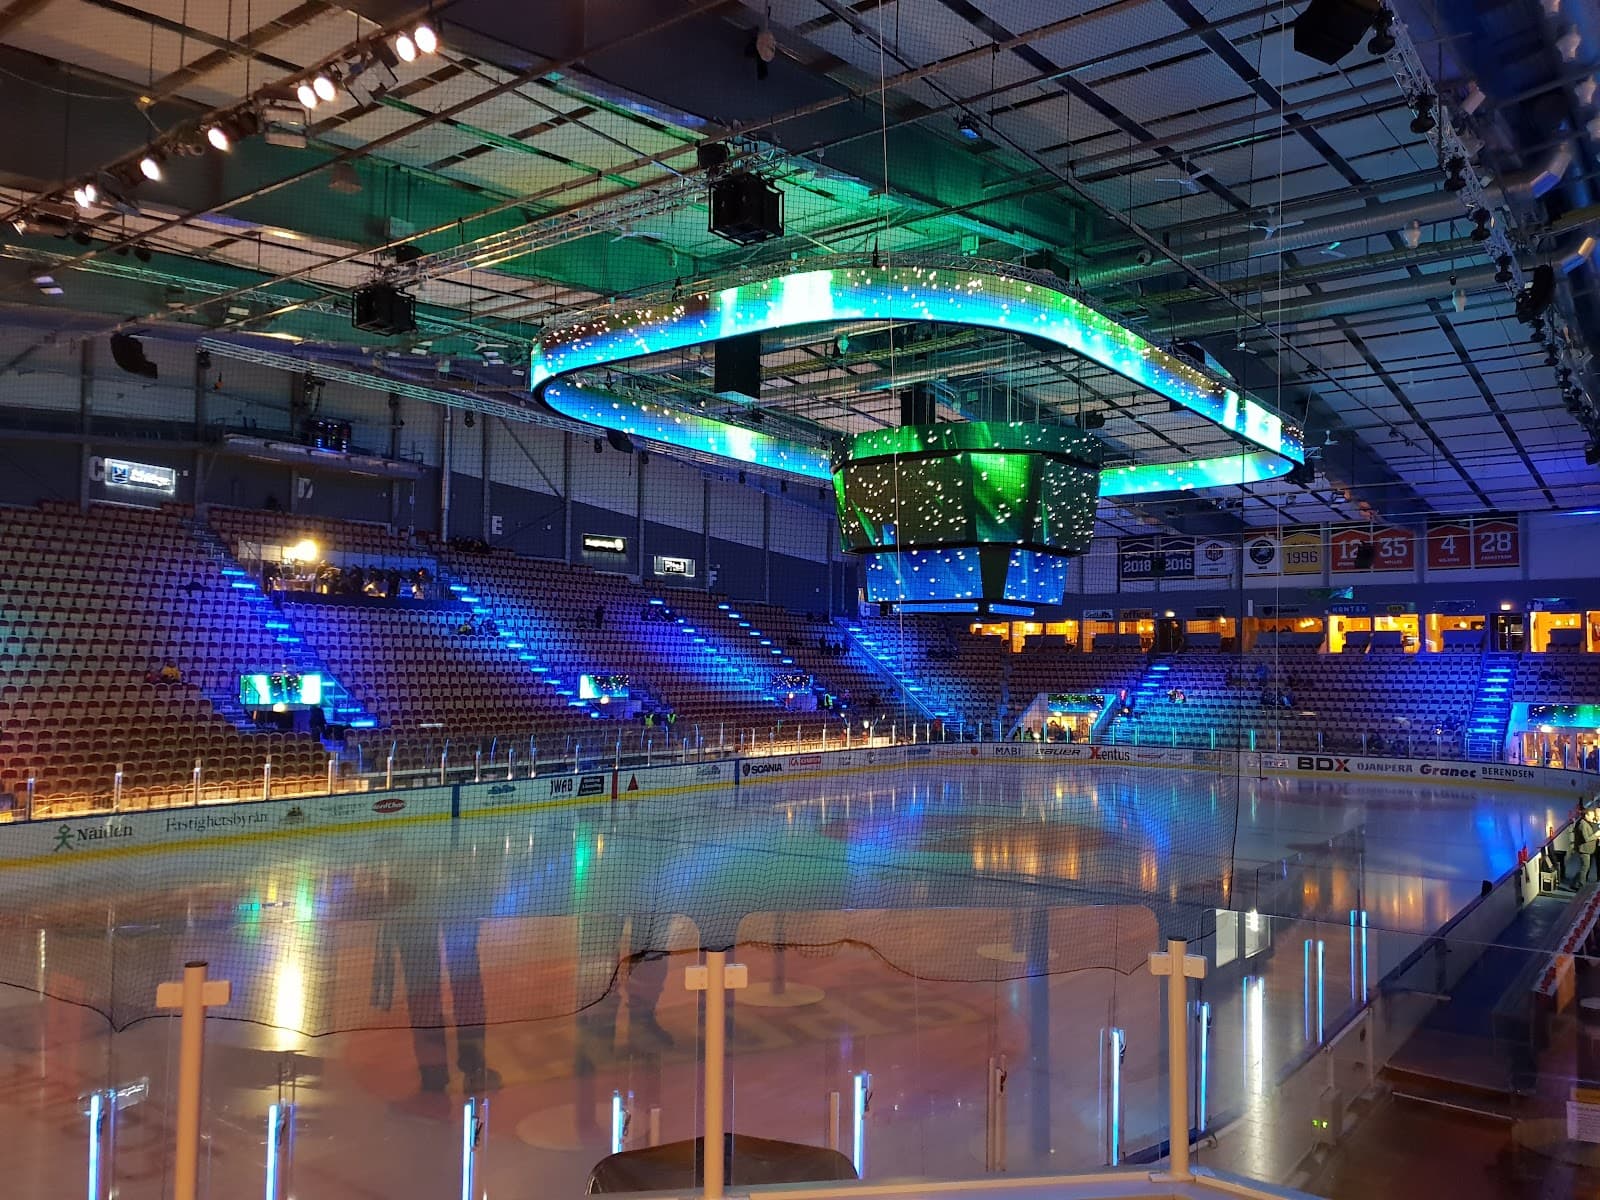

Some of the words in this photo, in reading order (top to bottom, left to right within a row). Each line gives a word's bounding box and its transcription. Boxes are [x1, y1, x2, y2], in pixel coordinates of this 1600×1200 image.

[491, 515, 503, 535] E
[1379, 537, 1408, 558] 35
[1440, 535, 1456, 555] 4
[1481, 531, 1511, 553] 28
[1165, 557, 1193, 572] 2016
[1287, 550, 1318, 565] 1996
[1123, 560, 1152, 574] 2018
[751, 763, 783, 775] SCANIA
[1297, 756, 1350, 772] BDX
[1420, 763, 1477, 778] Granec
[1482, 767, 1535, 779] BERENDSEN
